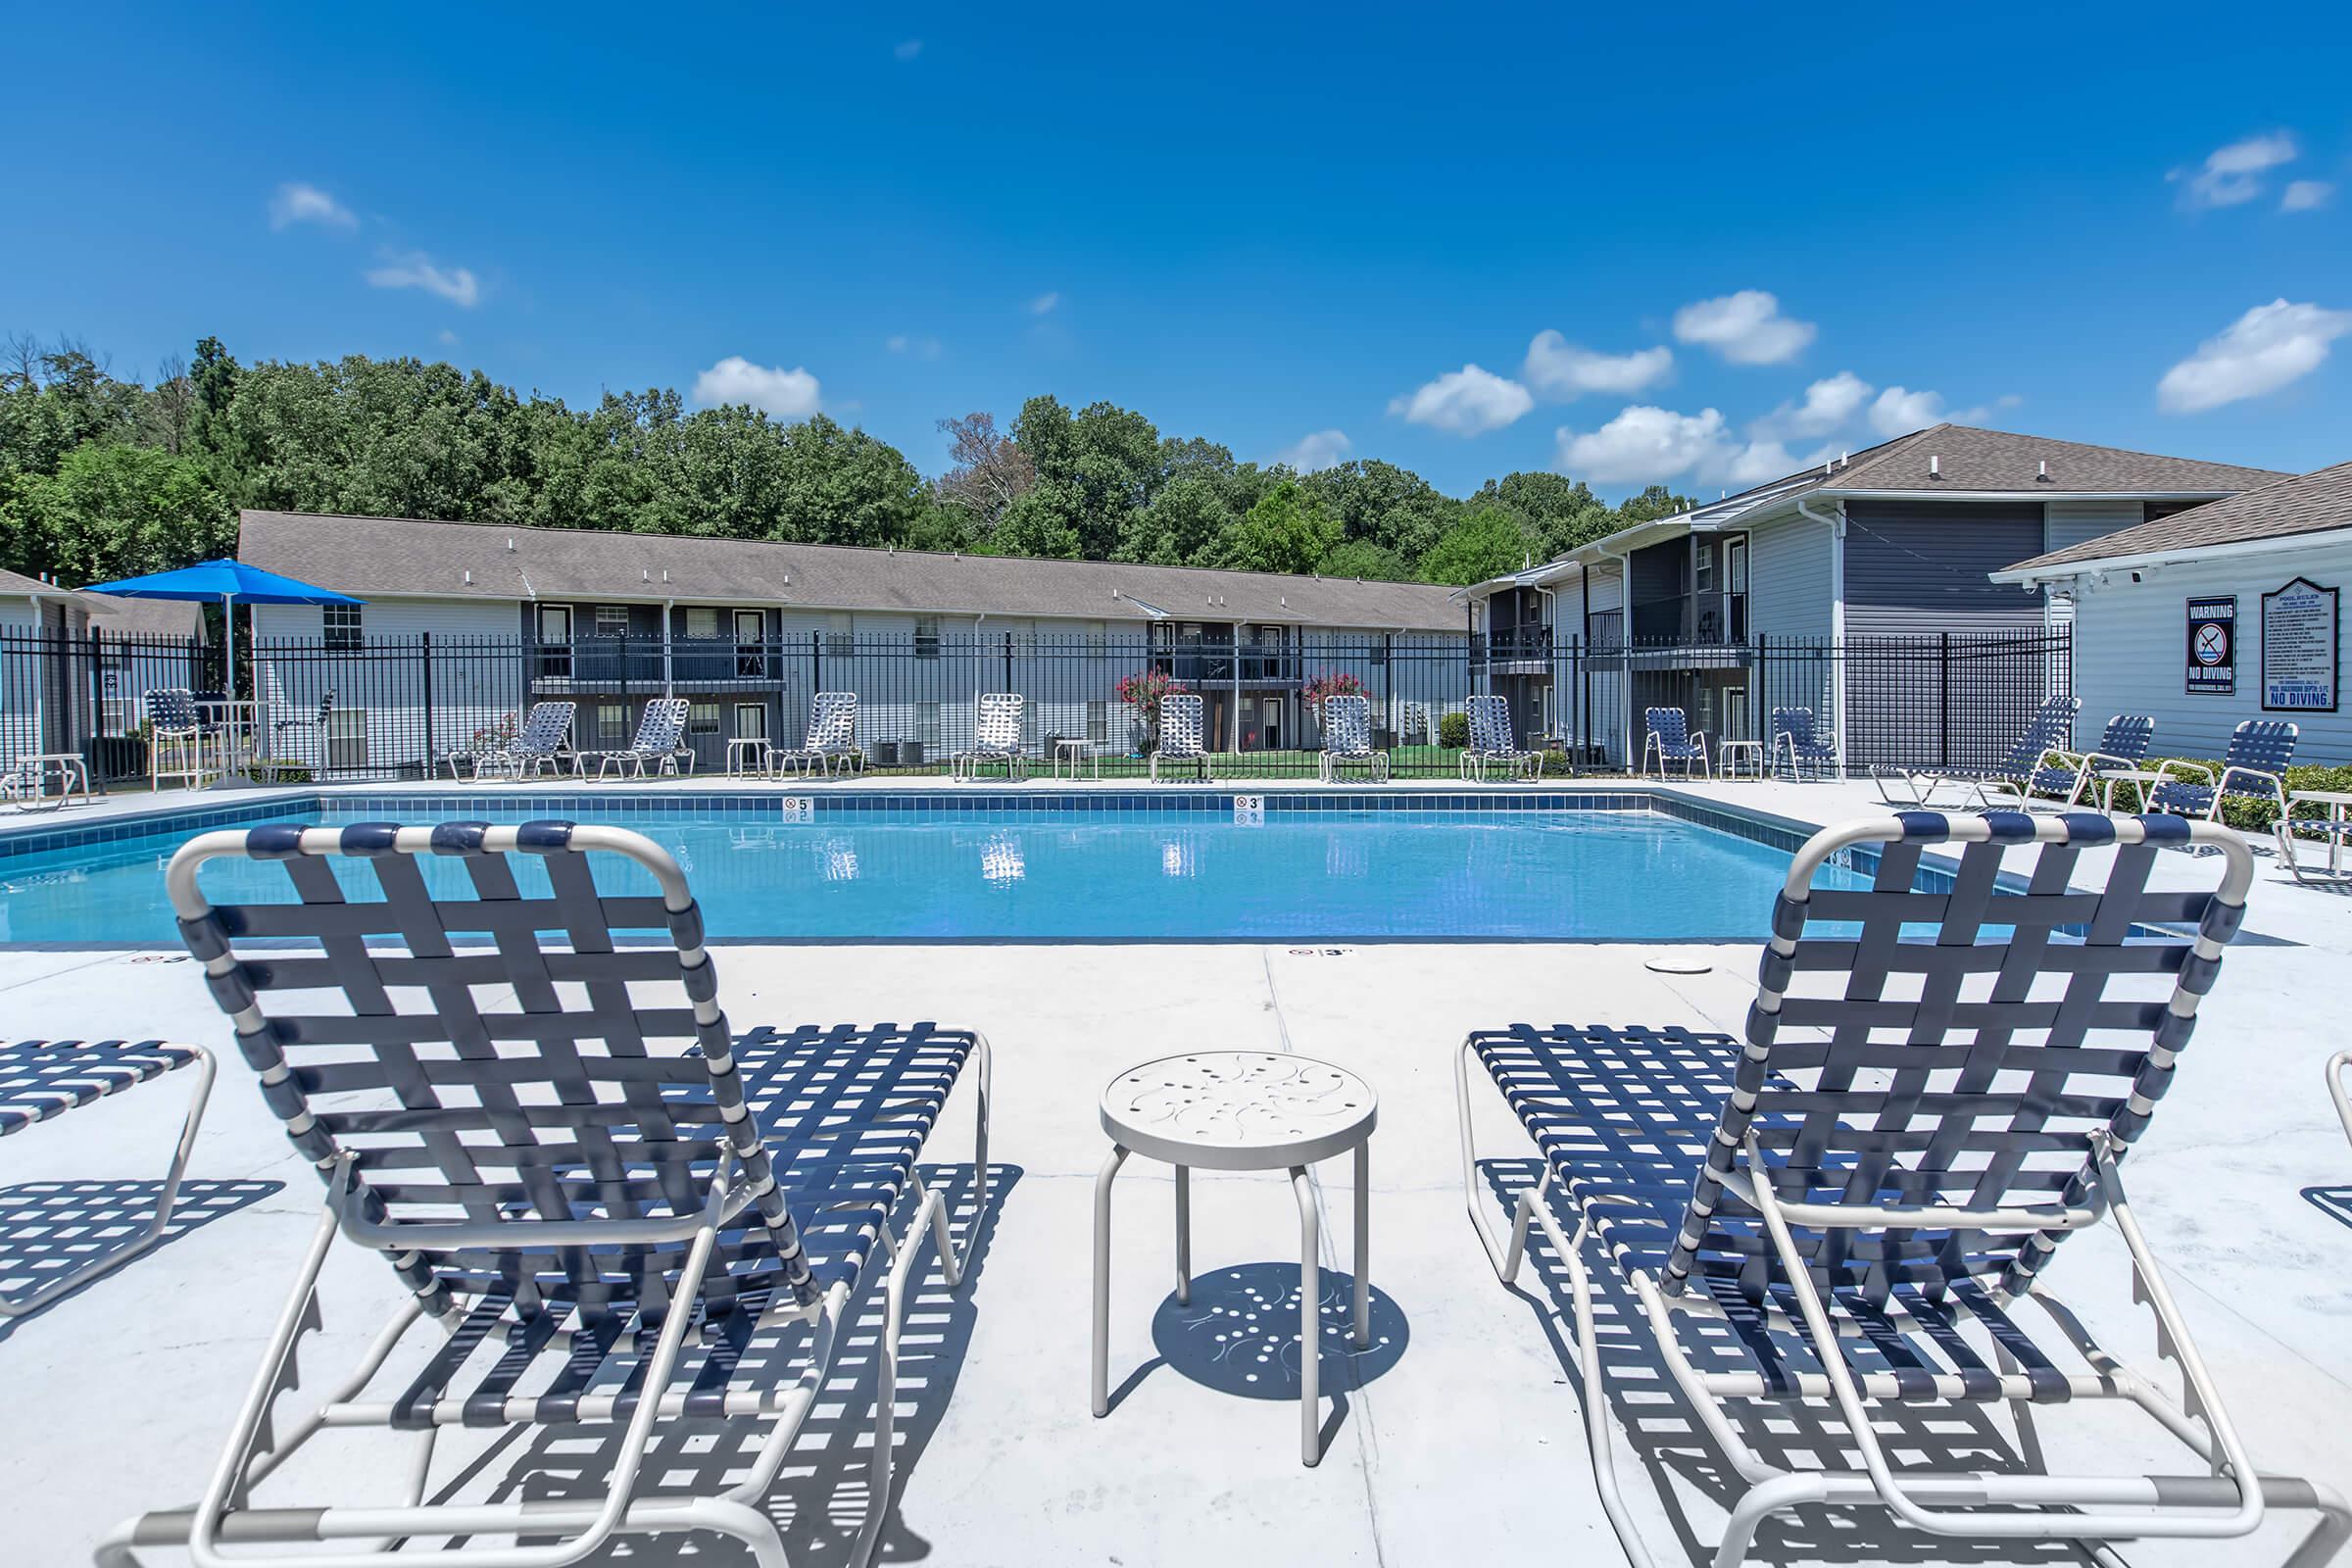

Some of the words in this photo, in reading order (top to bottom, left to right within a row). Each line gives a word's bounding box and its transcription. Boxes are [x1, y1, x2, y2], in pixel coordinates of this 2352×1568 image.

[2189, 605, 2233, 619] WARNING
[2188, 665, 2201, 680] NO
[2202, 666, 2232, 681] DIVING
[2271, 693, 2285, 706] NO
[2289, 693, 2327, 707] DIVING
